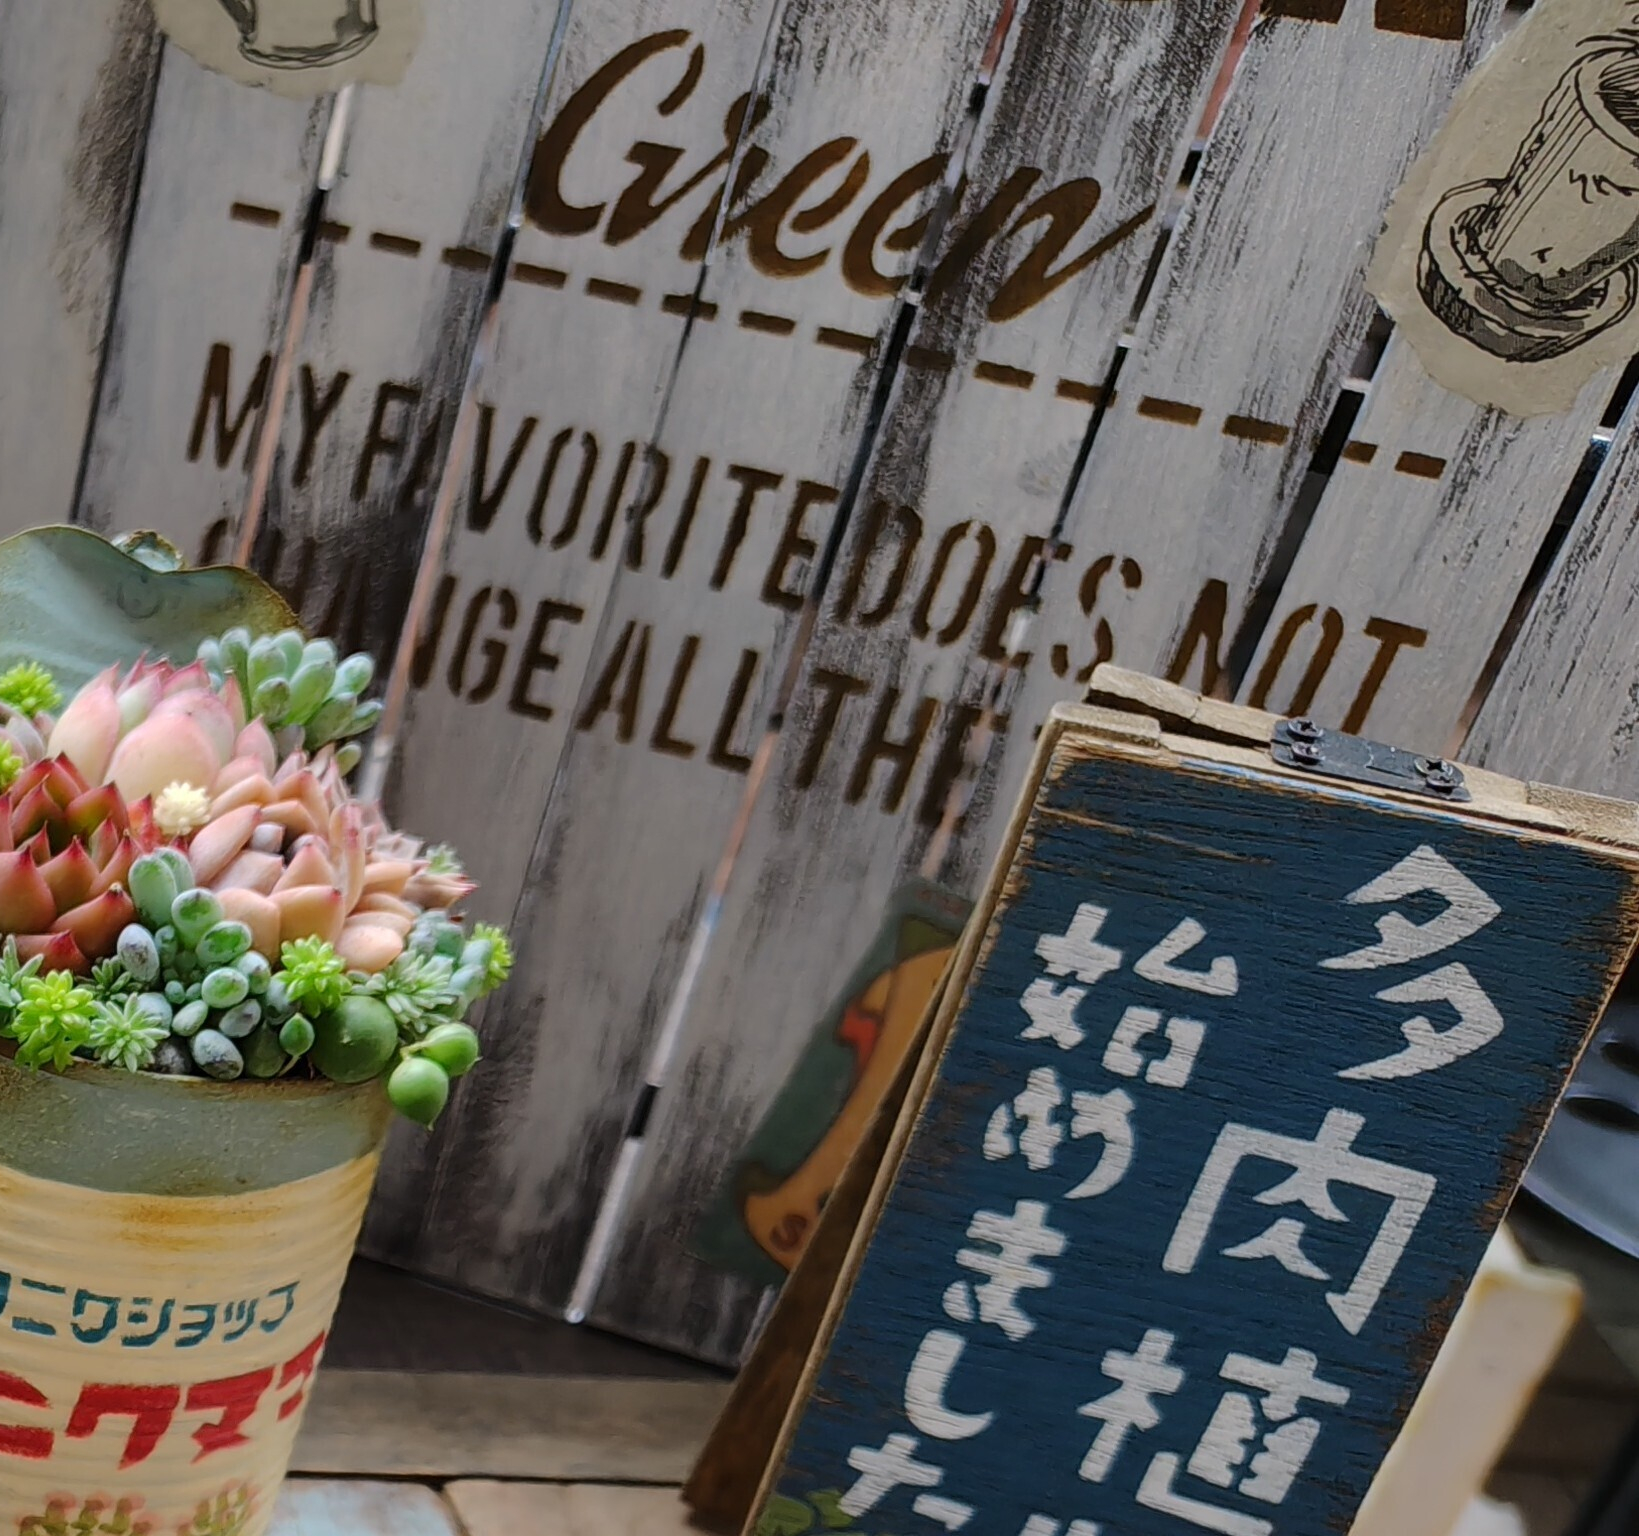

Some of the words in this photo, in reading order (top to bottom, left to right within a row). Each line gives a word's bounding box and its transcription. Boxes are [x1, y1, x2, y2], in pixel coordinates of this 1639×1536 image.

[525, 28, 1157, 323] Green
[186, 341, 352, 488] MY
[832, 499, 1143, 684] DOES
[1164, 577, 1429, 737] NOT
[576, 619, 761, 773] ALL
